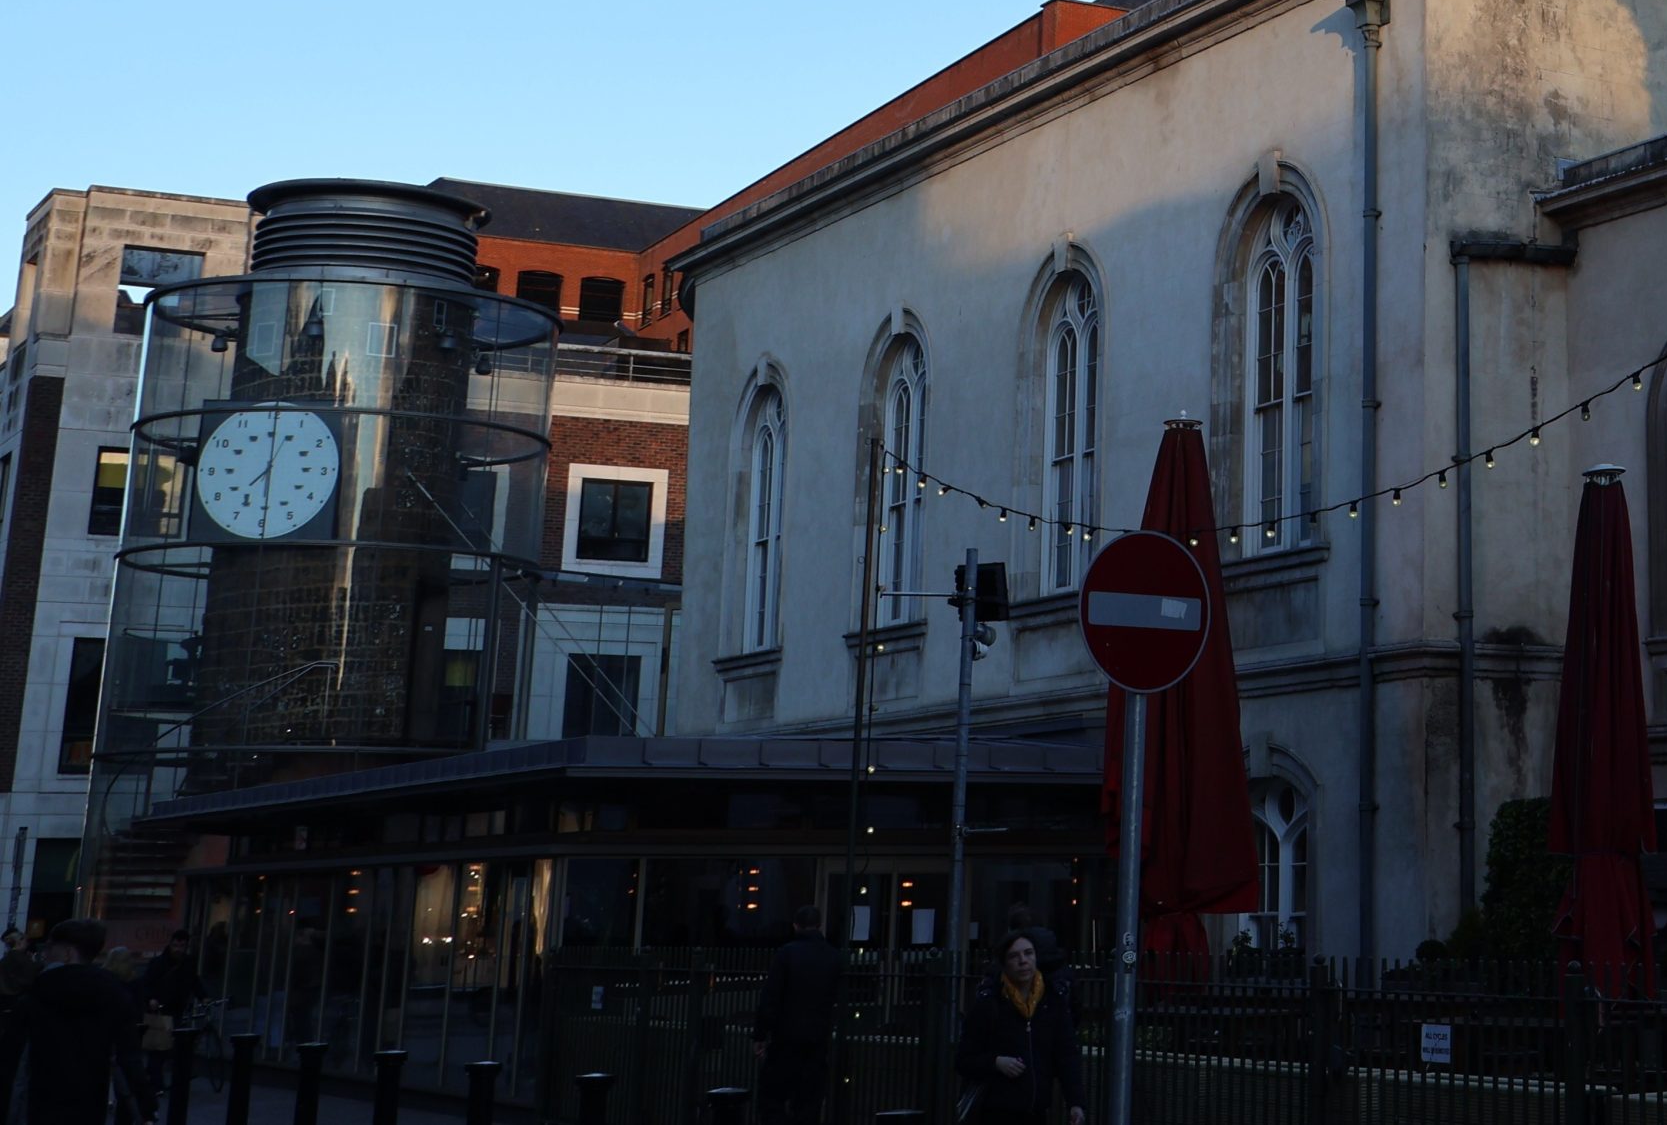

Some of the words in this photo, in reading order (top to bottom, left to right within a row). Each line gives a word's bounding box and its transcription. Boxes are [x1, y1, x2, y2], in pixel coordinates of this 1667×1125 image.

[238, 419, 248, 428] 11
[215, 439, 229, 448] 10
[315, 439, 323, 448] 2
[207, 467, 215, 476] 9
[320, 467, 328, 476] 3
[214, 492, 221, 501] 8
[306, 492, 313, 501] 4
[233, 511, 240, 520] 7
[287, 511, 294, 520] 5
[258, 519, 265, 528] 6
